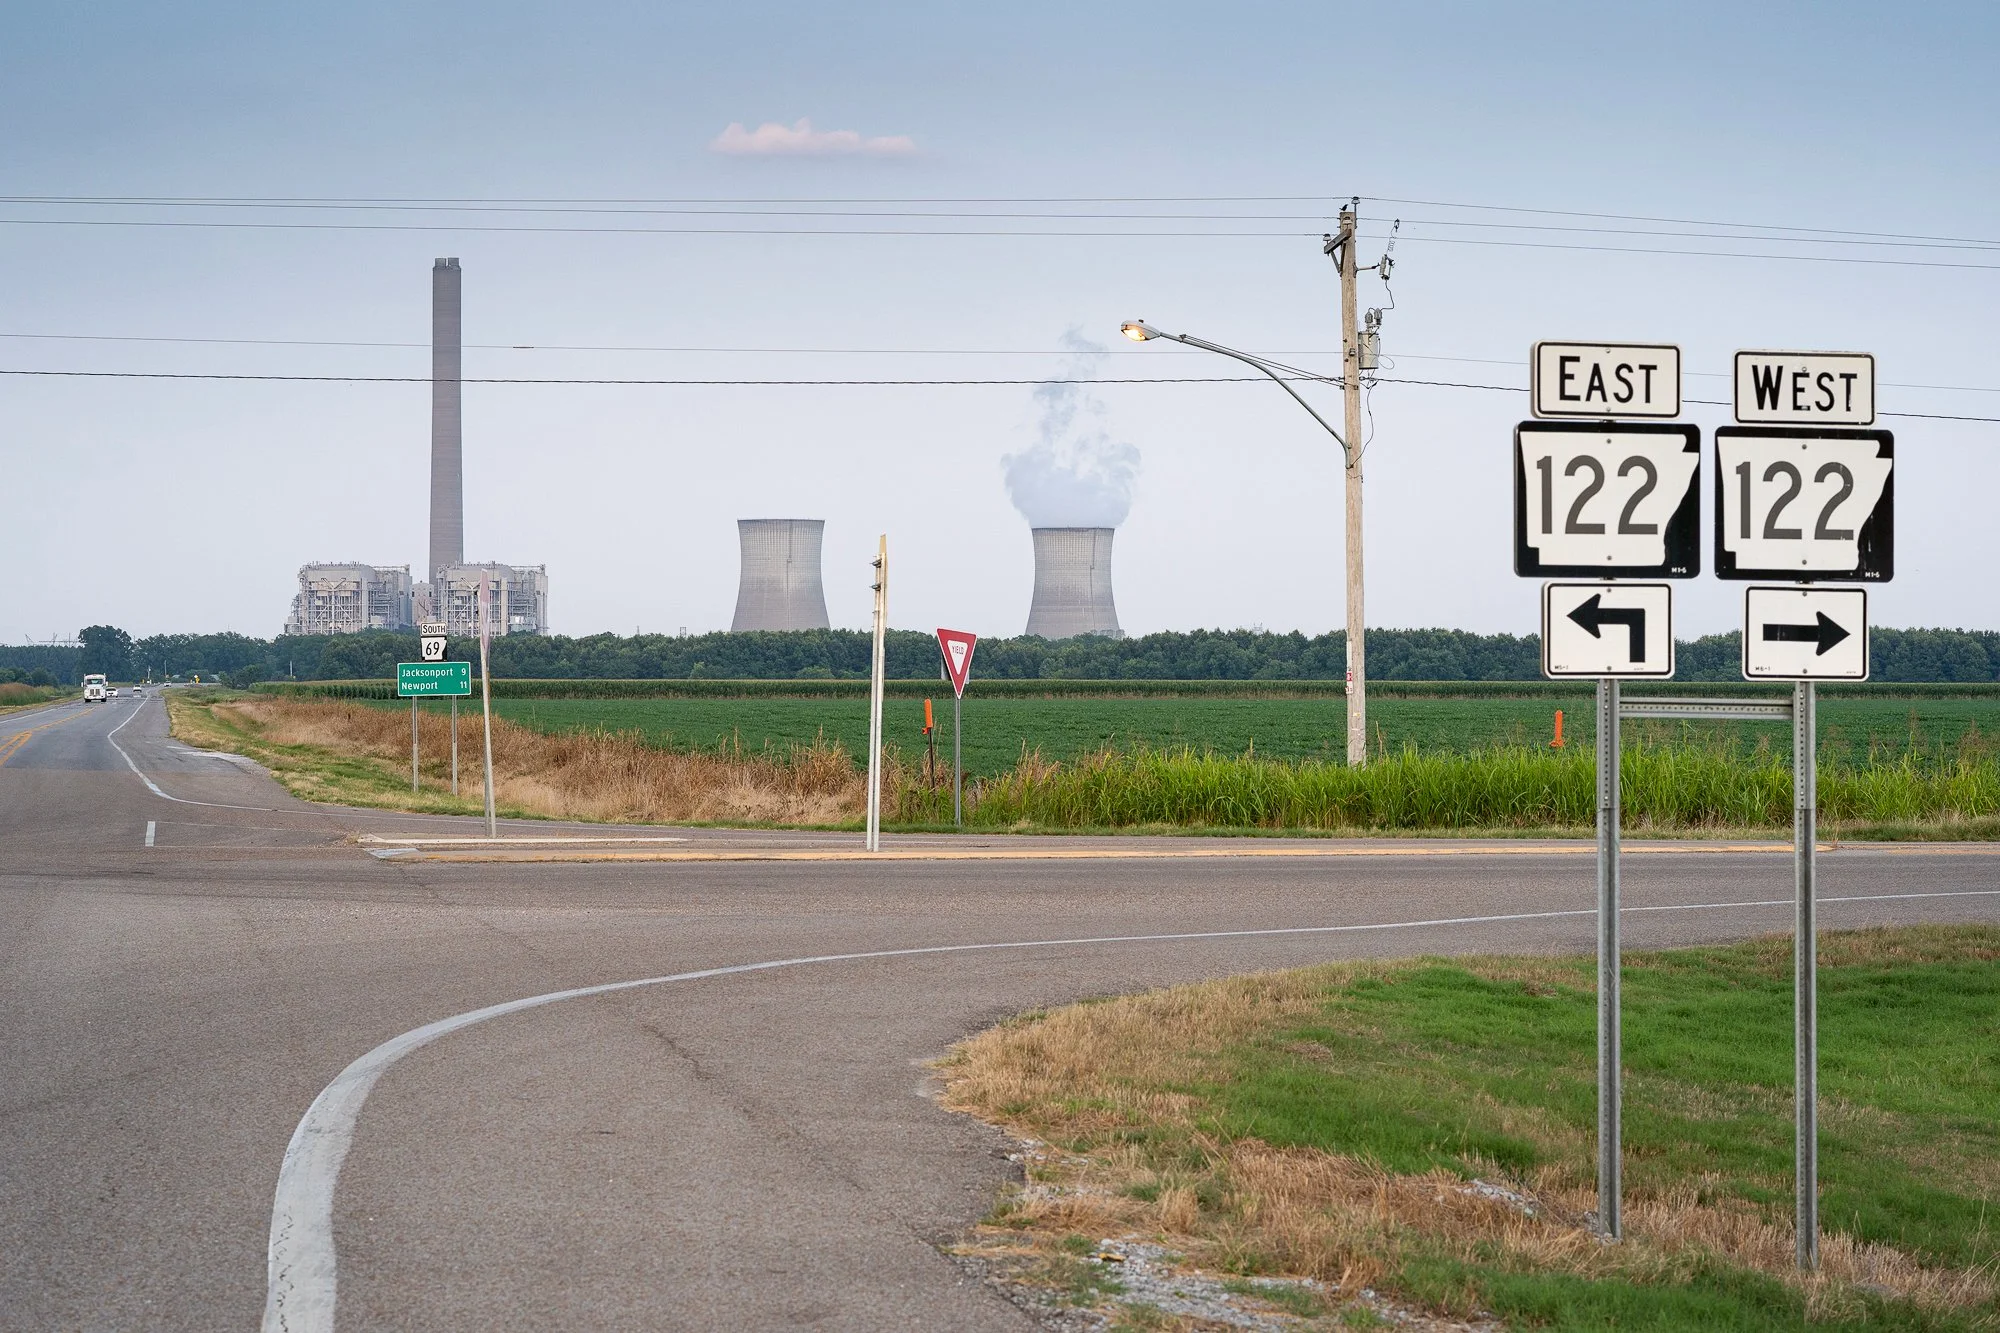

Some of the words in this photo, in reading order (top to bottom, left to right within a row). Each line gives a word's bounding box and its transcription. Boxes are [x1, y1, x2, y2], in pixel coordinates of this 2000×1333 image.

[1559, 355, 1658, 404] EAST
[1752, 365, 1858, 412] WEST
[1536, 454, 1659, 535] 122
[1735, 460, 1854, 541] 122
[423, 625, 445, 633] SOUTH
[426, 642, 440, 656] 69
[952, 646, 965, 655] YIELD
[402, 668, 454, 678] Jacksonport
[461, 668, 466, 676] 9
[402, 682, 438, 691] Newport
[460, 681, 467, 689] 11
